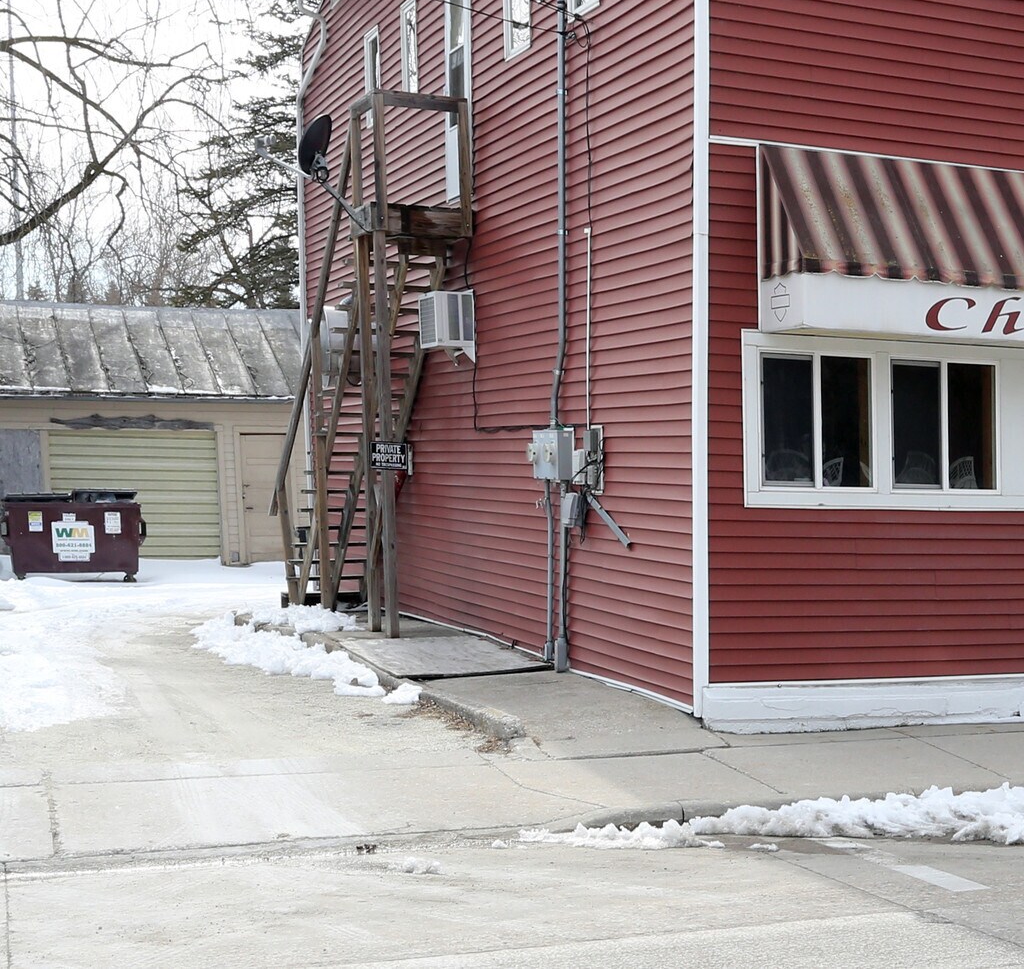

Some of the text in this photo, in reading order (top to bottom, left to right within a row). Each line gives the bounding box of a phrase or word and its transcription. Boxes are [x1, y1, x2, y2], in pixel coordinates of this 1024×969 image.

[376, 443, 401, 453] PRIVATE
[372, 453, 405, 463] PROPERTY
[55, 527, 89, 538] WM
